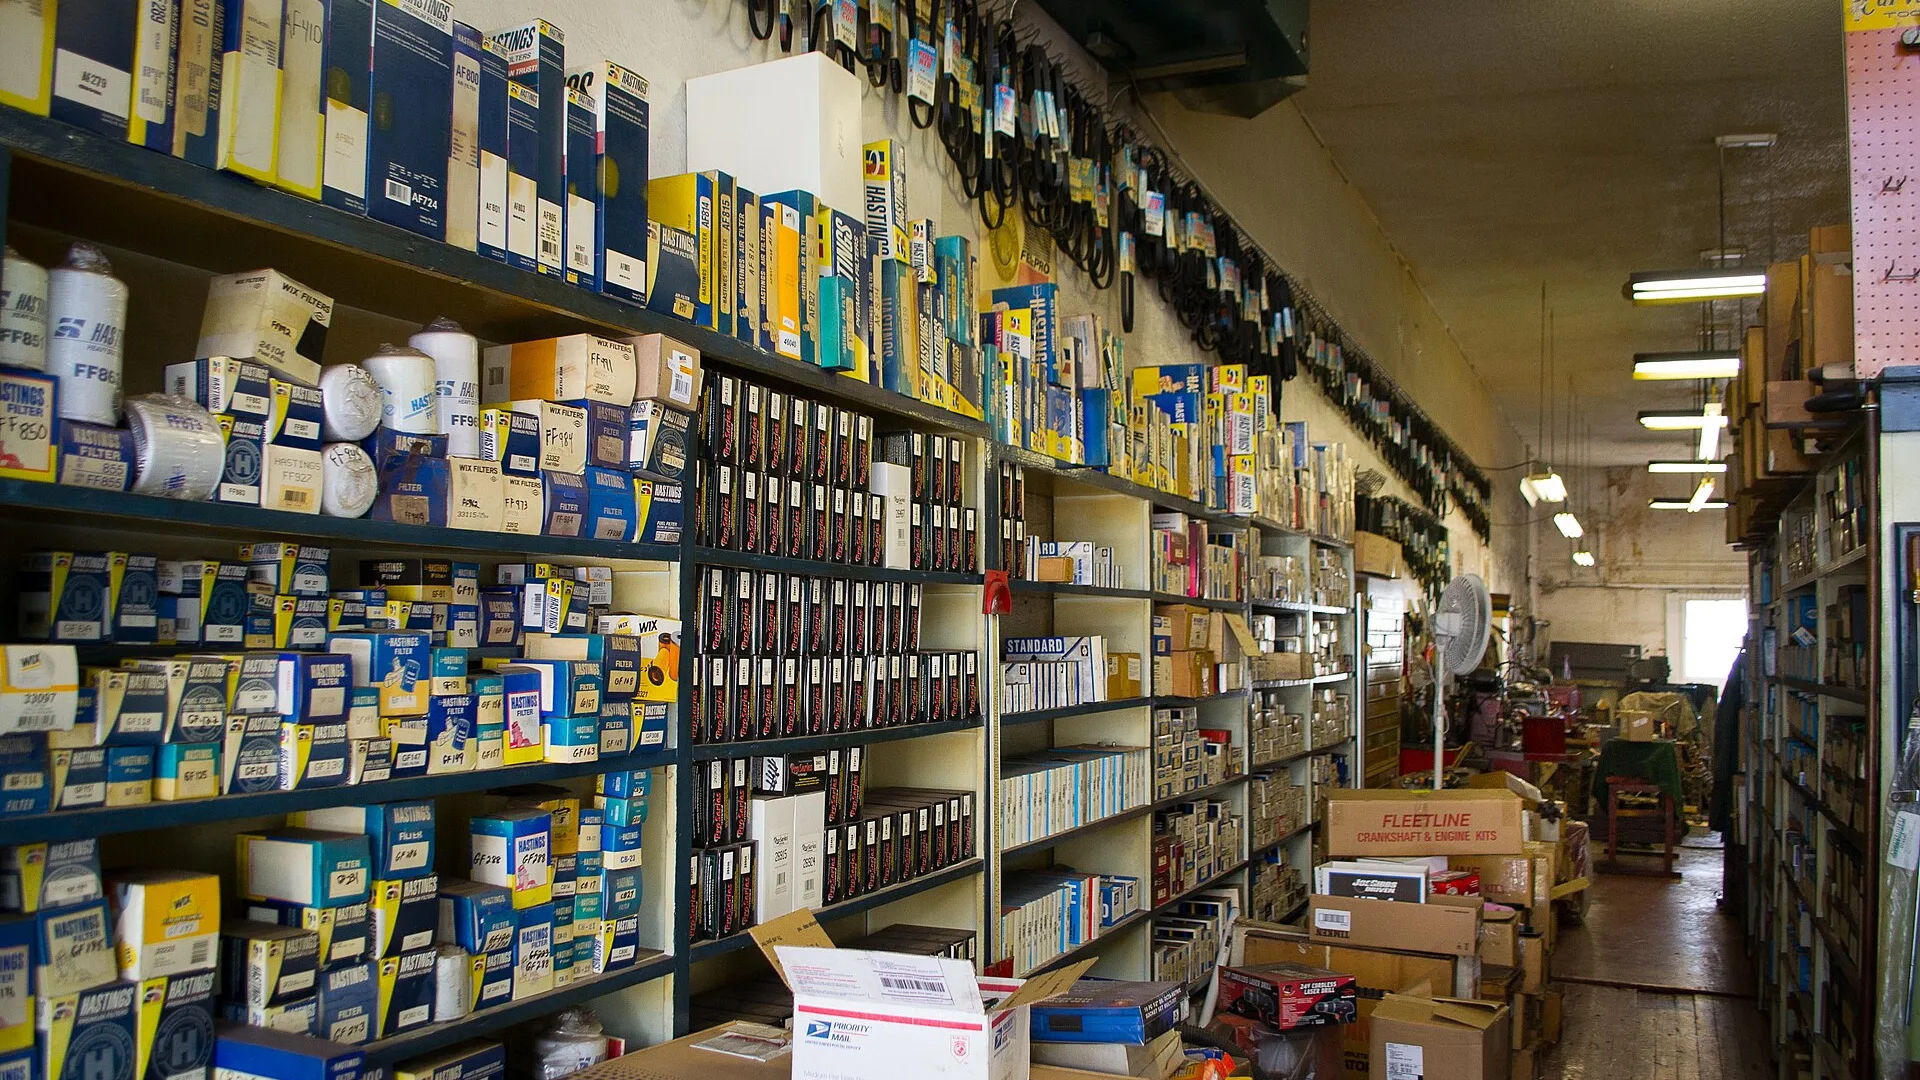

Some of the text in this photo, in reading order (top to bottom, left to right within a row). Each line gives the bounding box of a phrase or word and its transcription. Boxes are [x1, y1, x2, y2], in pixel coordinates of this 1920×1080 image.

[456, 64, 479, 86] AF800
[622, 72, 648, 94] HASTINGS
[412, 192, 438, 210] AF724
[701, 201, 710, 228] AF814
[722, 200, 730, 232] AF815
[662, 228, 695, 253] HASTINGS
[914, 242, 925, 279] HASTINGS
[282, 282, 330, 314] WIX FILTERS
[258, 340, 286, 358] 24104
[596, 340, 632, 354] WIX FILTERS
[920, 312, 931, 374] HASTINGS
[933, 318, 944, 376] HASTINGS
[212, 377, 221, 411] HASTINGS
[7, 403, 44, 417] FILTER
[550, 406, 584, 420] WIX FILTERS
[596, 406, 625, 422] HASTINGS
[512, 416, 538, 431] HASTINGS
[664, 408, 690, 428] HASTINGS
[72, 427, 120, 450] HASTINGS
[604, 427, 620, 437] FILTER
[546, 428, 574, 454] FF984
[80, 446, 122, 462] FILTER
[103, 462, 124, 476] 855
[274, 456, 320, 471] HASTINGS
[459, 464, 498, 476] WIX FILTERS
[86, 474, 122, 489] FF855
[283, 472, 312, 482] FF927
[552, 472, 582, 488] HASTINGS
[596, 472, 626, 490] HASTINGS
[398, 482, 423, 493] FILTER
[520, 480, 542, 489] FILTERS
[654, 484, 682, 498] HASTINGS
[504, 498, 528, 510] FF973
[559, 502, 578, 512] FILTER
[603, 507, 622, 516] FILTER
[300, 548, 330, 560] HASTINGS
[456, 584, 474, 596] GF97
[343, 602, 366, 613] HASTINGS
[412, 604, 434, 614] HASTINGS
[488, 601, 514, 612] HASTINGS
[549, 596, 560, 632] HASTINGS
[618, 622, 629, 630] WIX
[638, 620, 658, 633] WIX
[389, 636, 420, 648] HASTINGS
[612, 638, 638, 652] HASTINGS
[1007, 639, 1063, 653] STANDARD
[20, 652, 41, 667] WIX
[244, 658, 278, 672] HASTINGS
[190, 663, 226, 678] HASTINGS
[310, 663, 345, 678] HASTINGS
[574, 663, 600, 676] HASTINGS
[129, 674, 166, 689] HASTINGS
[318, 678, 340, 686] FILTER
[24, 694, 56, 704] 33097
[443, 697, 470, 707] HASTINGS
[510, 694, 538, 710] HASTINGS
[516, 709, 534, 717] FILTER
[602, 702, 629, 716] HASTINGS
[645, 705, 666, 716] HASTINGS
[247, 716, 281, 731] HASTINGS
[314, 724, 346, 739] HASTINGS
[73, 750, 105, 764] HASTINGS
[442, 752, 464, 764] GF149
[572, 746, 596, 758] GF163
[394, 806, 432, 824] HASTINGS
[1382, 814, 1472, 828] FLEETLINE
[398, 831, 423, 840] FILTER
[1357, 830, 1497, 842] CRANKSHAFT & ENGINE KITS
[50, 838, 96, 858] HASTINGS
[518, 836, 546, 853] HASTINGS
[336, 860, 362, 870] FILTER
[558, 858, 576, 868] HASTINGS
[404, 876, 438, 898] HASTINGS
[174, 894, 192, 910] WIX
[481, 895, 506, 906] HASTINGS
[336, 904, 367, 920] HASTINGS
[54, 914, 100, 939] HASTINGS
[492, 921, 510, 931] FILTER
[616, 916, 638, 932] HASTINGS
[521, 928, 549, 944] HASTINGS
[531, 939, 548, 949] FILTER
[487, 952, 512, 968] HASTINGS
[593, 936, 602, 972] HASTINGS
[400, 950, 436, 974] HASTINGS
[329, 966, 369, 991] HASTINGS
[1311, 981, 1336, 989] CORDLESS
[168, 972, 215, 1000] HASTINGS
[80, 987, 134, 1015] HASTINGS
[338, 1006, 362, 1020] FILTER
[833, 1022, 870, 1032] PRIORITY
[832, 1034, 850, 1042] MAIL
